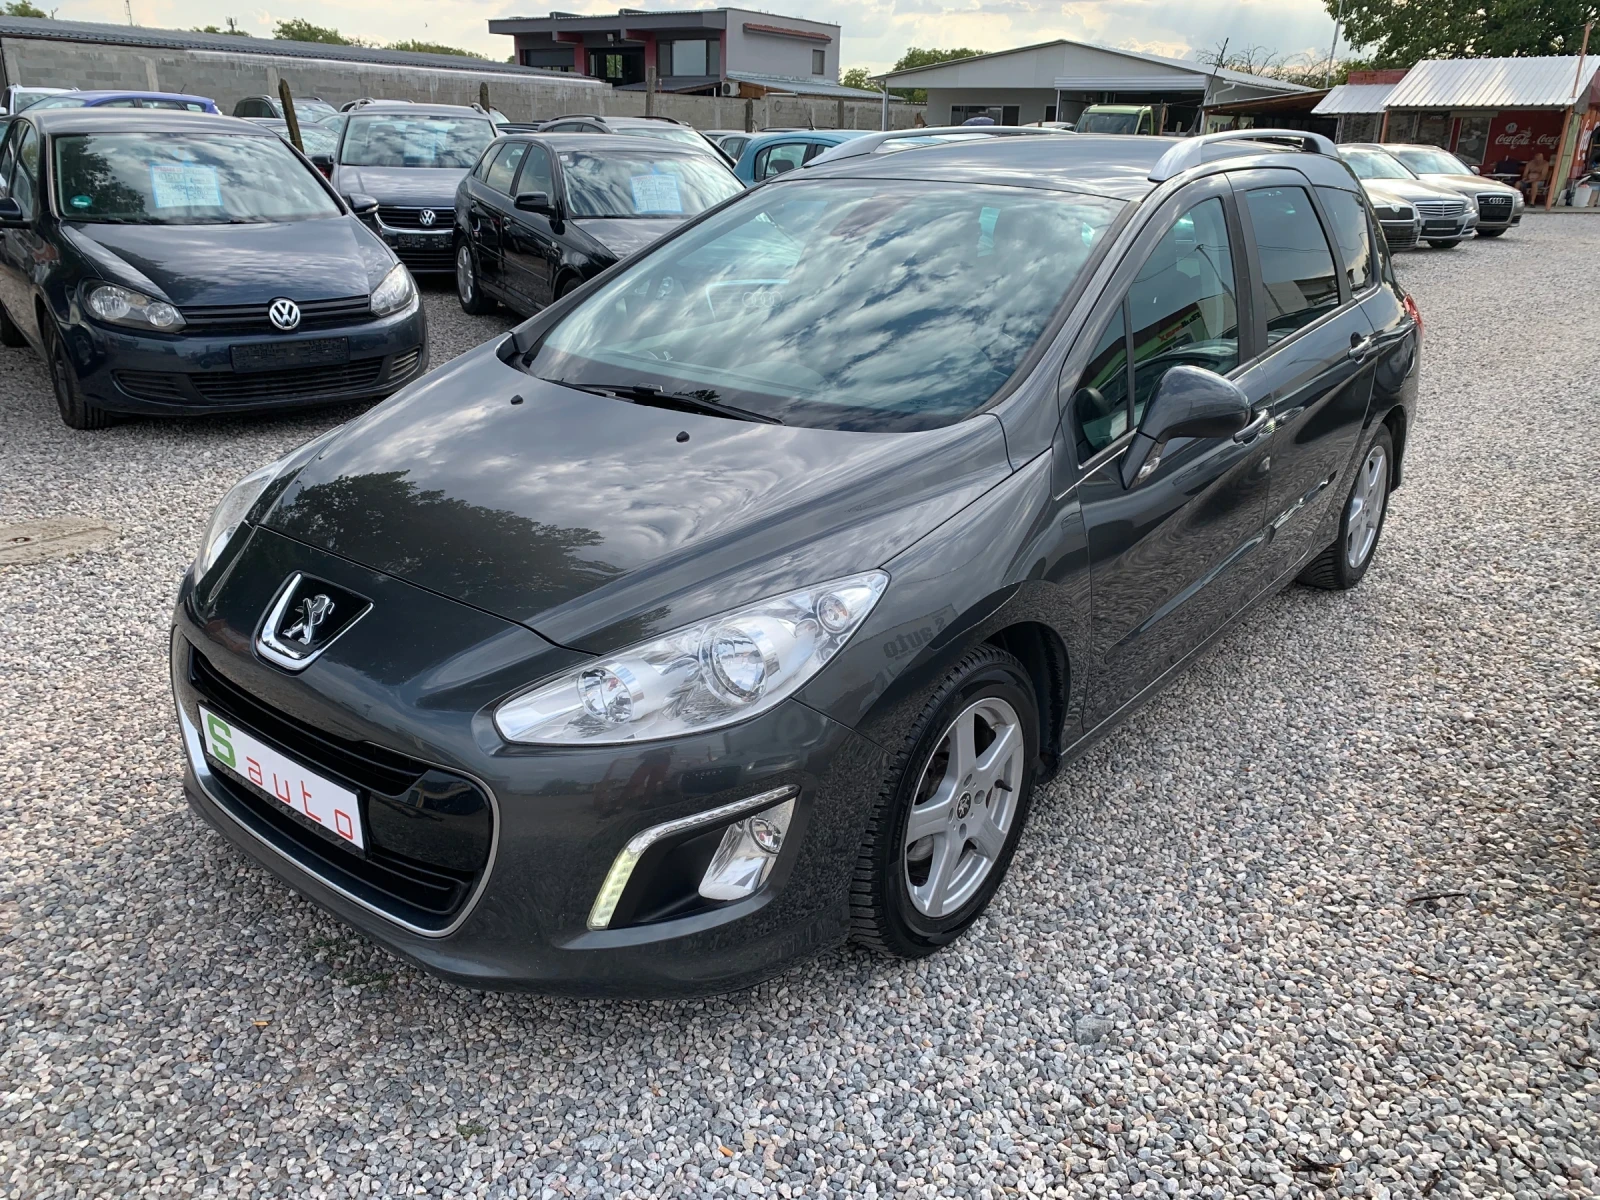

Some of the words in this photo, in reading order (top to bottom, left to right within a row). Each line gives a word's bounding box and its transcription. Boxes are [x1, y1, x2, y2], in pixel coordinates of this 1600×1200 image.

[269, 299, 300, 330] VW
[207, 713, 236, 768] S
[246, 756, 354, 841] auto
